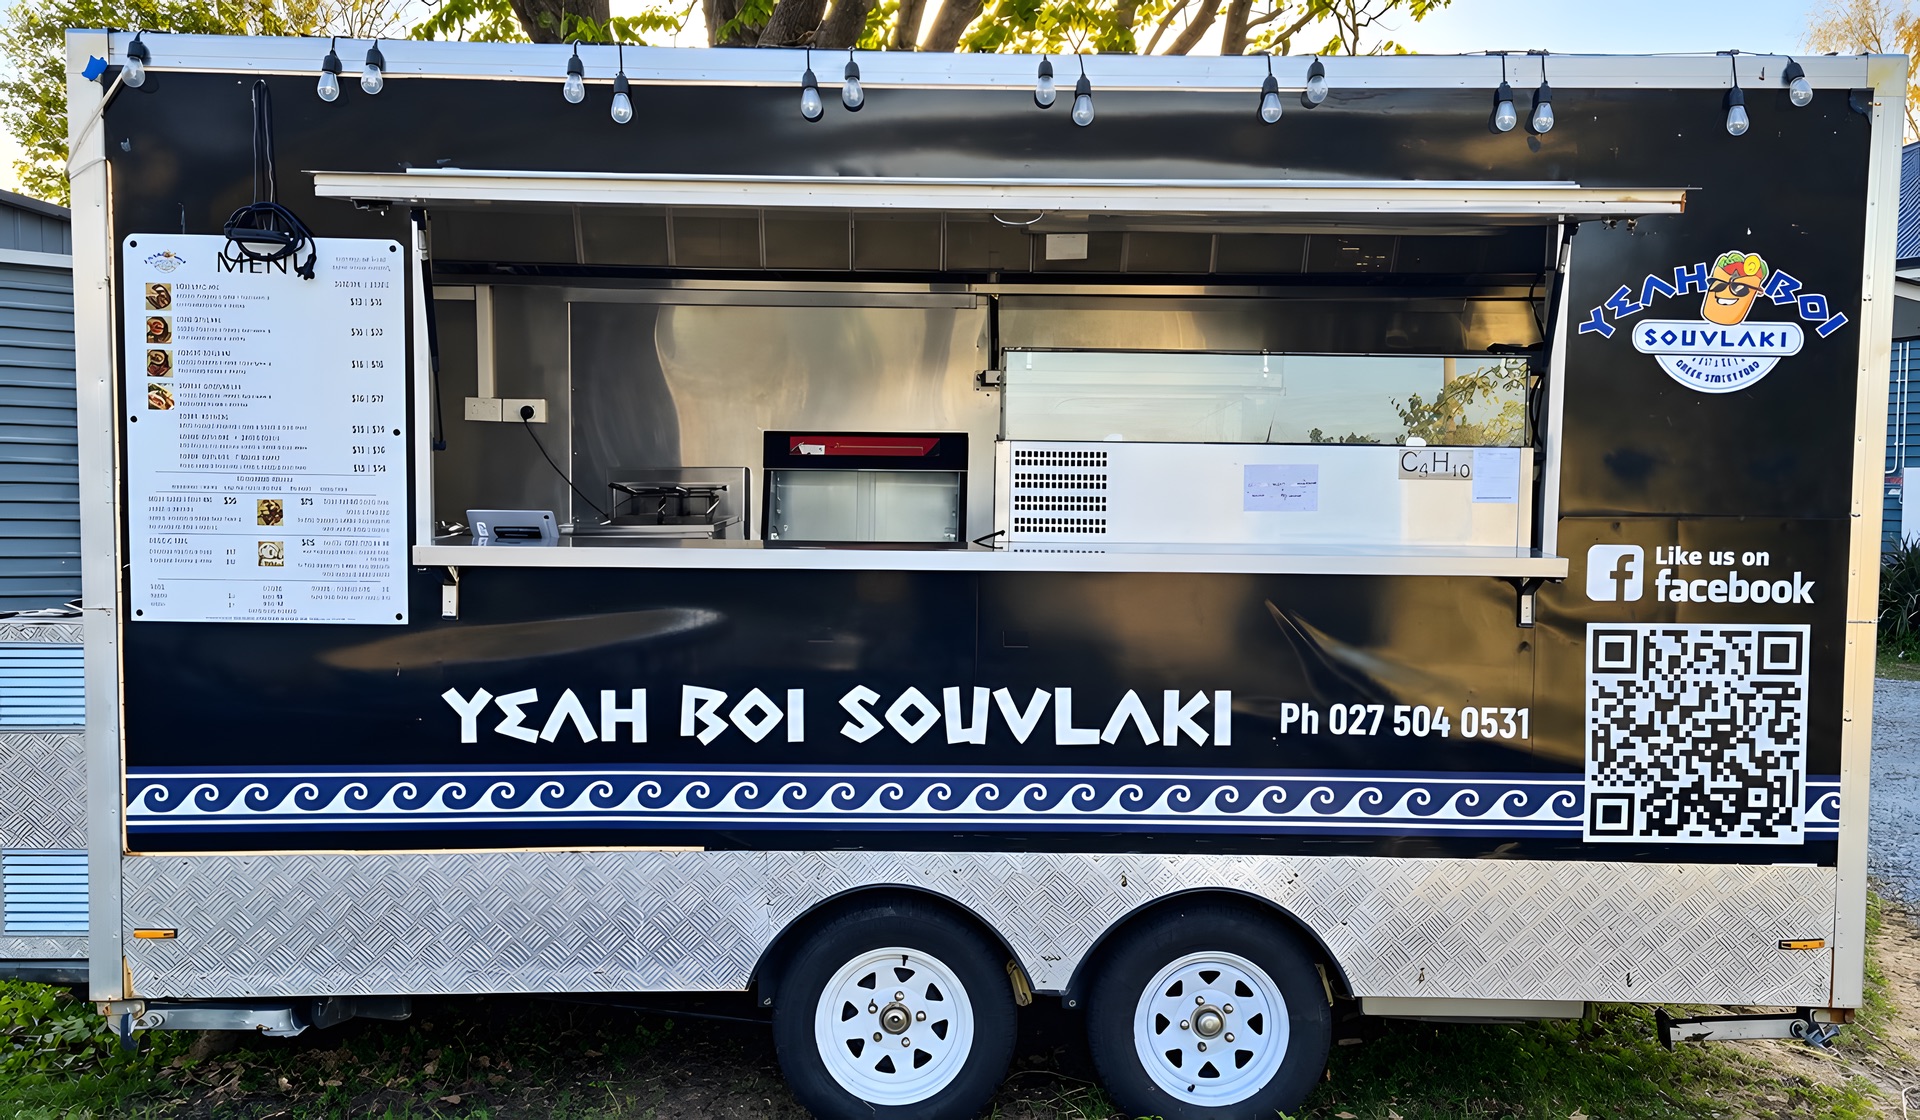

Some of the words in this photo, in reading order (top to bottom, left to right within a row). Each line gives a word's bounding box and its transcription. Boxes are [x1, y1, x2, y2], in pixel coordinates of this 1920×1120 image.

[1579, 262, 1709, 339] YEAH
[1764, 269, 1849, 338] BOI
[1645, 328, 1787, 348] SOUVLAKI
[1656, 546, 1702, 565] Like
[1709, 551, 1734, 565] us
[1741, 551, 1769, 566] on
[1655, 568, 1816, 604] facebook
[441, 686, 647, 744] YEAH
[680, 684, 804, 746] BOI
[838, 684, 1232, 747] SOUVLAKI
[1281, 703, 1319, 734] Ph
[1329, 703, 1385, 736] 027
[1393, 705, 1450, 738] 504
[1461, 706, 1529, 740] 0531
